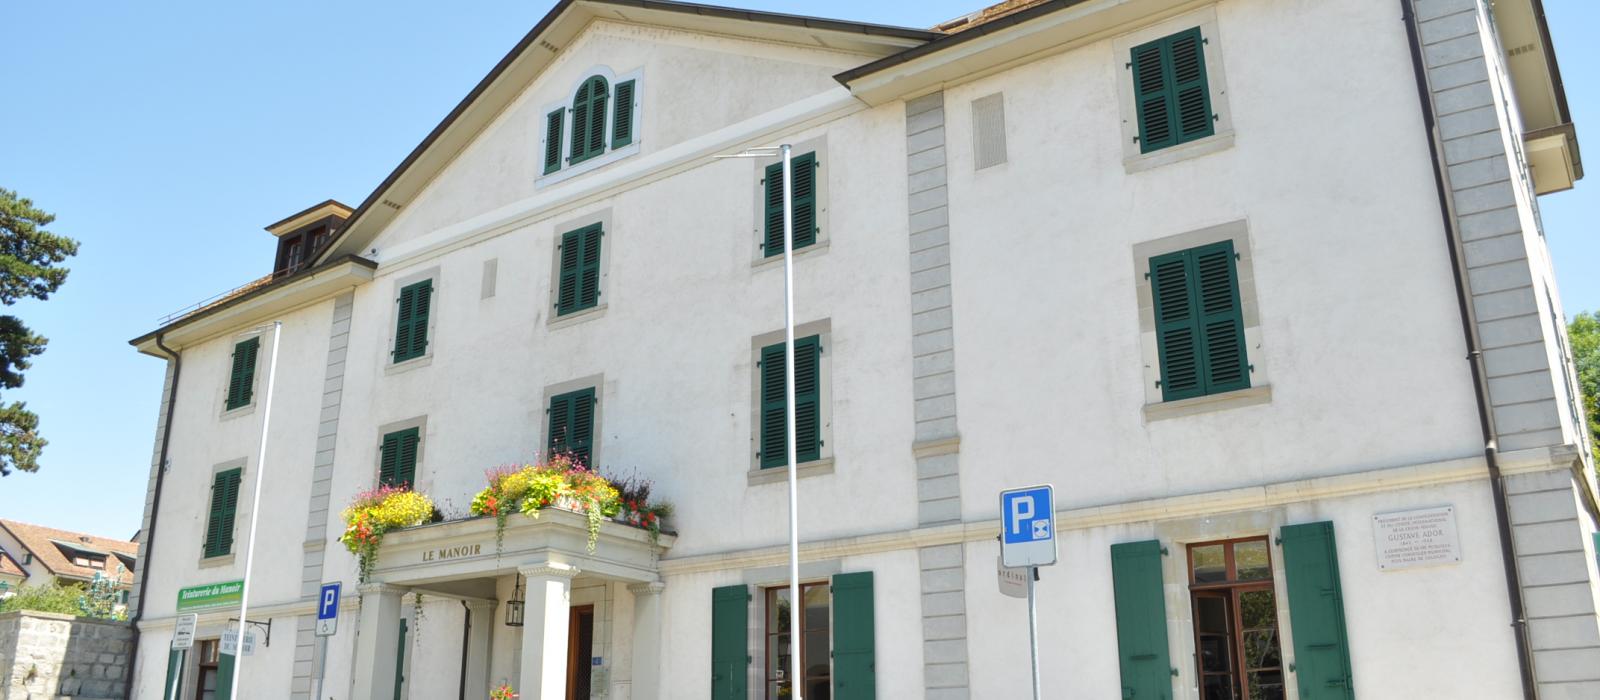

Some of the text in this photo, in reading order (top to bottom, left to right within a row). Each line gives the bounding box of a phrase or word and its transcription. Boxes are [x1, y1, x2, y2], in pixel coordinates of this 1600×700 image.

[1012, 495, 1035, 534] P
[1388, 529, 1444, 541] GUSTAVE ADOR
[422, 544, 481, 562] LE MANOIR
[323, 590, 335, 615] P
